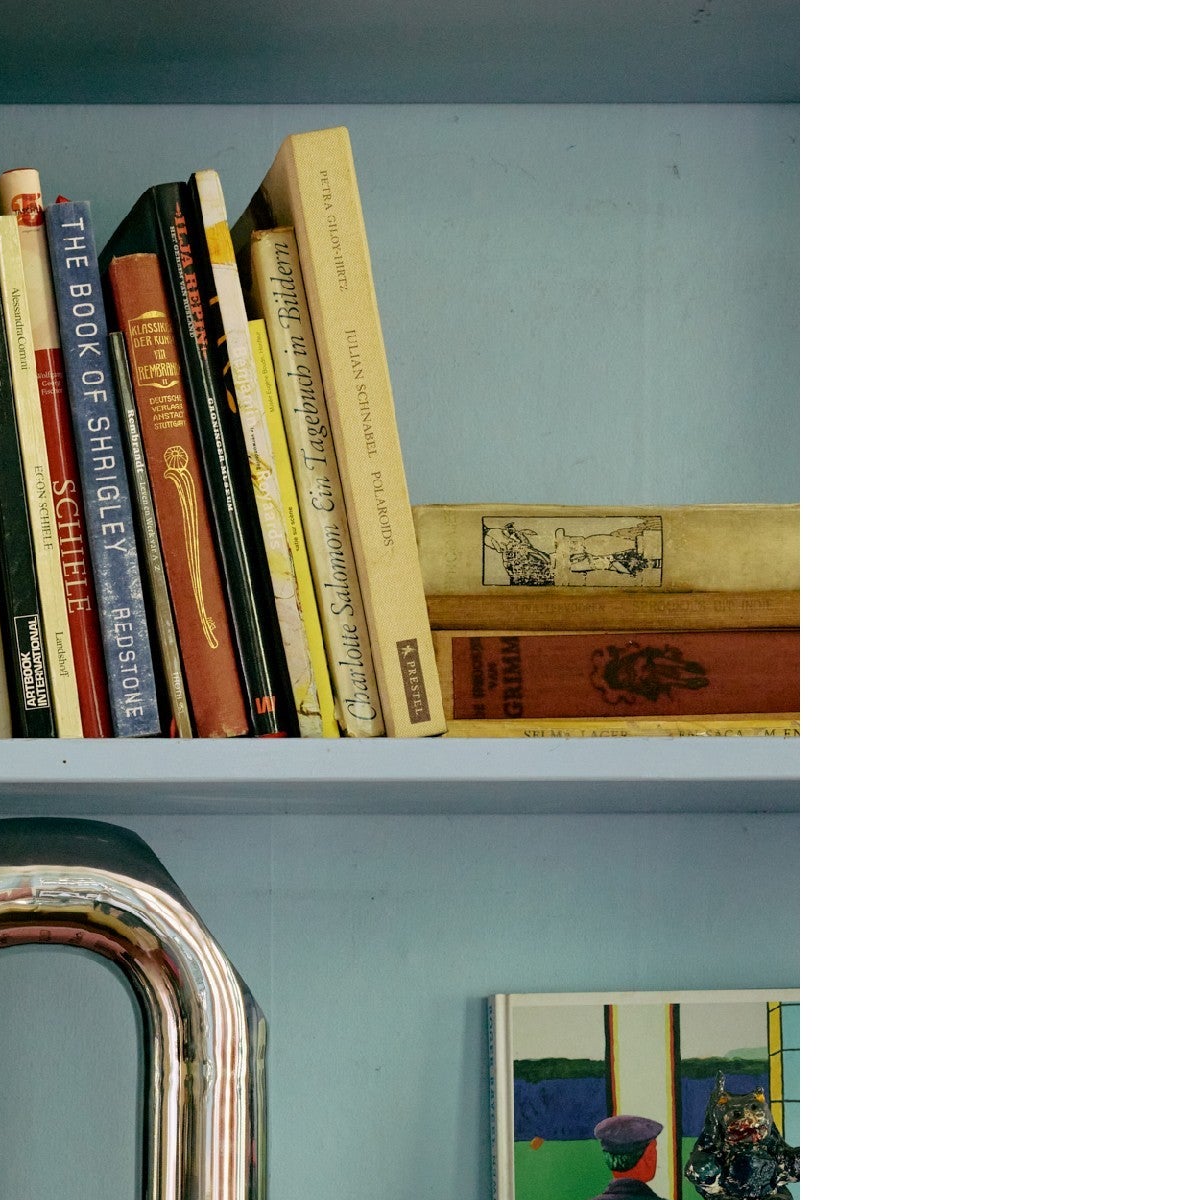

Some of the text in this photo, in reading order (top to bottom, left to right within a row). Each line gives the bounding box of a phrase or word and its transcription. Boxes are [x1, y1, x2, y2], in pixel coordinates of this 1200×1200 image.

[319, 170, 333, 210] PETRA
[61, 217, 128, 554] THE BOOK OF SHRIGLEY
[345, 329, 395, 548] JULIAN SCHNABEL POLAROIDS
[270, 242, 377, 721] Charlotte Salomon Ein Tagebuch in Bildern
[52, 479, 92, 614] SCHIELE
[20, 619, 51, 710] ARTBOOK INTERNATIONAL
[111, 607, 144, 718] REDSTONE
[406, 660, 422, 717] PRESTEL
